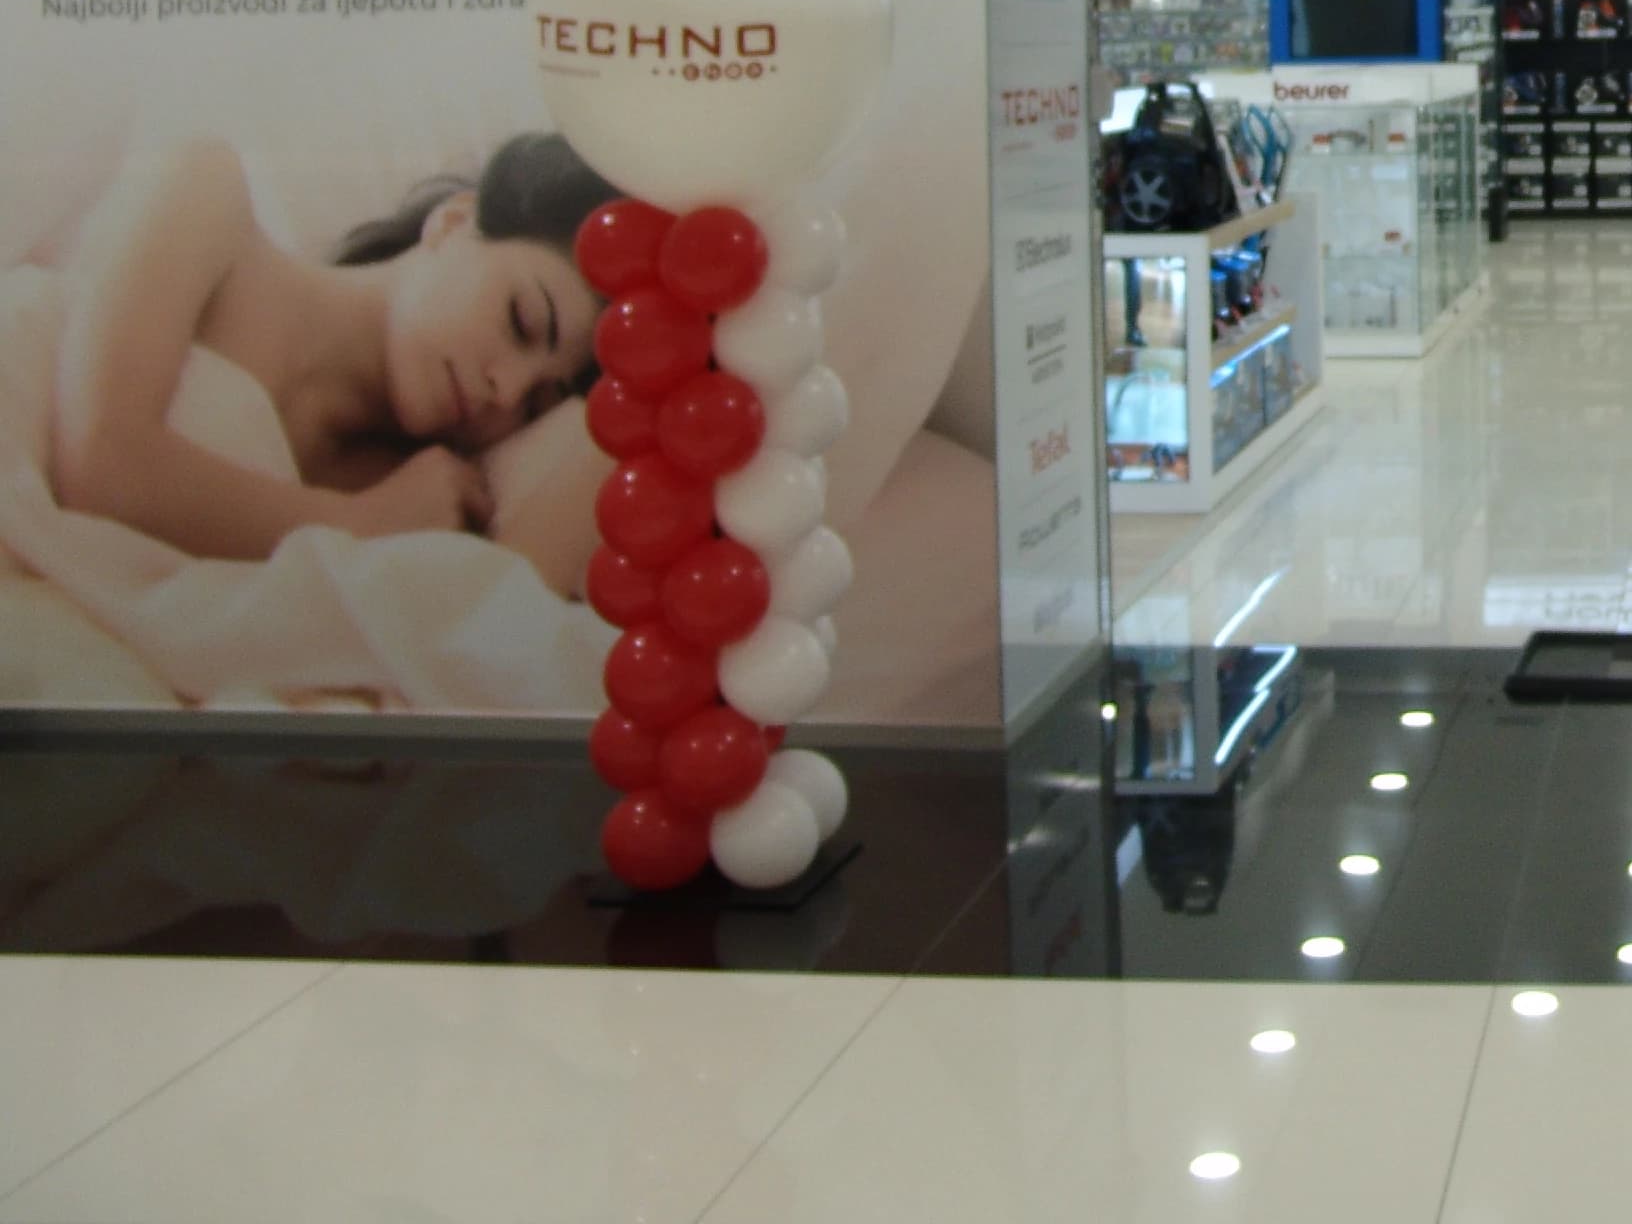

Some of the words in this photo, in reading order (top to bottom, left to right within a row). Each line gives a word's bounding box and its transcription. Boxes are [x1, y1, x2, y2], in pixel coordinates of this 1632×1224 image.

[536, 14, 777, 59] TECHNO
[1001, 85, 1080, 127] TECHNO
[1273, 80, 1350, 101] beurer
